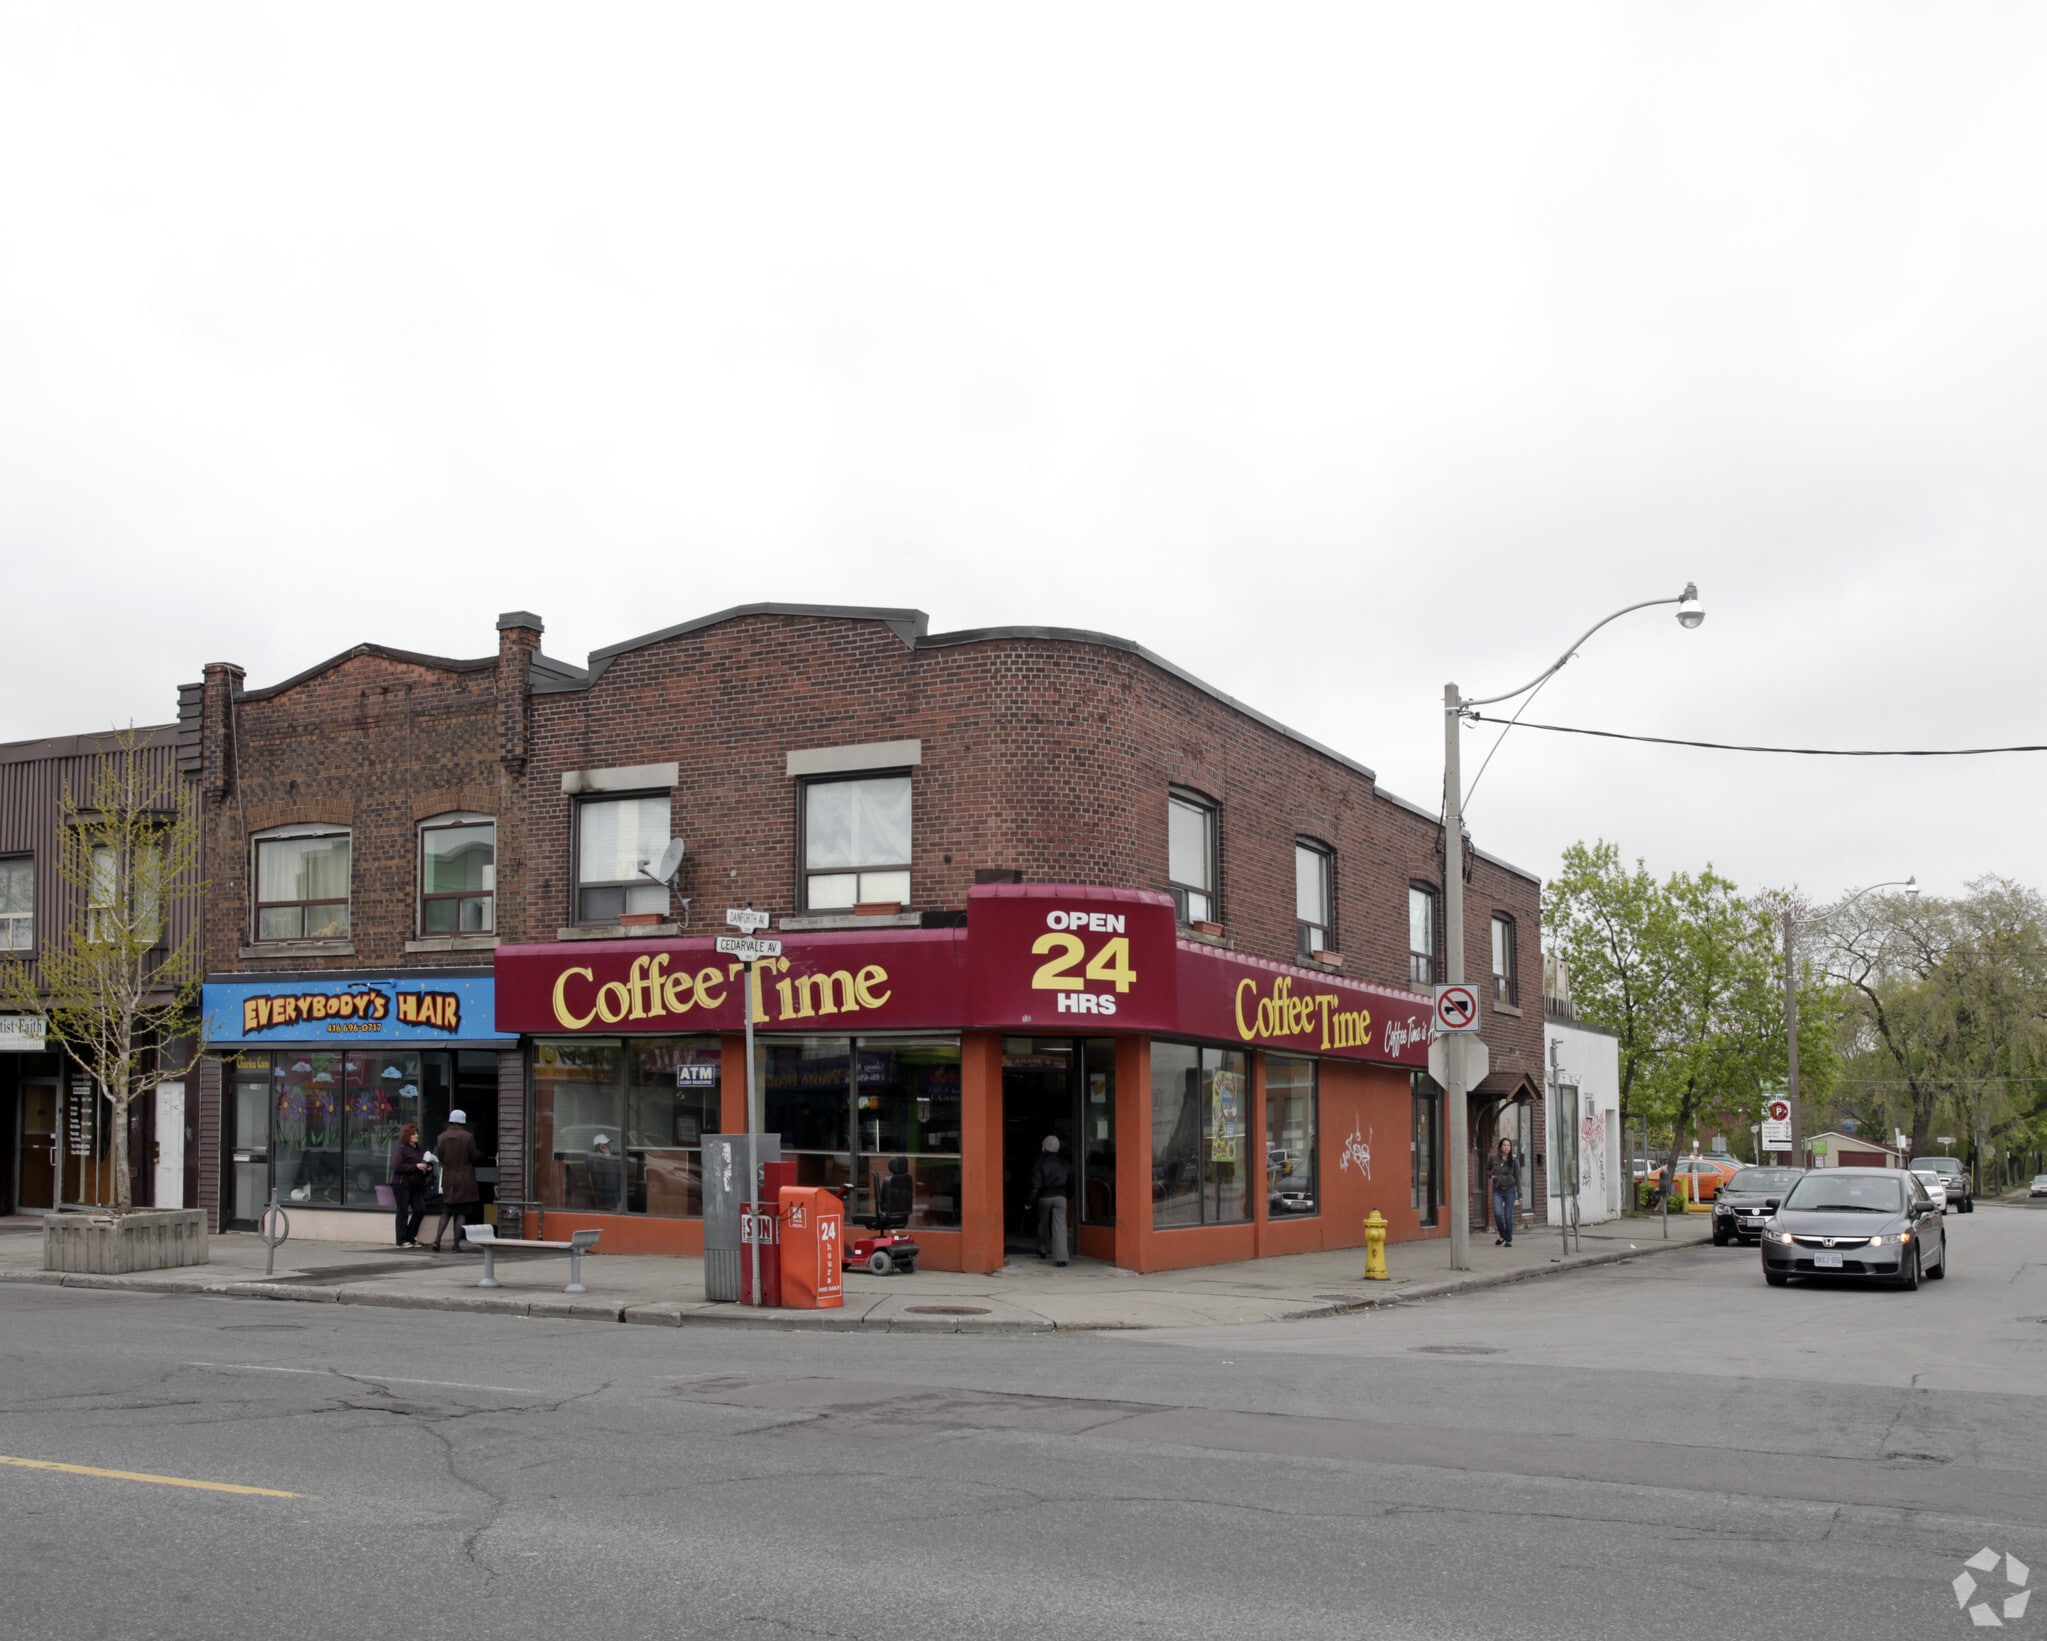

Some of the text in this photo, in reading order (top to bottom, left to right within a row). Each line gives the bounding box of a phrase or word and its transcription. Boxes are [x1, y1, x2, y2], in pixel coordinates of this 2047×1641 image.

[730, 911, 758, 925] DANFORTH
[1046, 910, 1125, 933] OPEN
[720, 939, 777, 953] CEDARVALE AV
[1031, 932, 1137, 993] 24
[552, 953, 892, 1030] Coffee Time
[243, 990, 459, 1034] EVERYBODY'S HAIR
[1057, 992, 1117, 1015] HRS
[1235, 976, 1315, 1041] Coffee
[1315, 994, 1372, 1050] Time
[19, 1018, 42, 1033] Faith
[326, 1023, 382, 1033] 416 696-0717
[1384, 1020, 1408, 1058] Coffee
[1407, 1016, 1421, 1048] Time
[680, 1067, 713, 1080] ATM
[821, 1221, 836, 1240] 24
